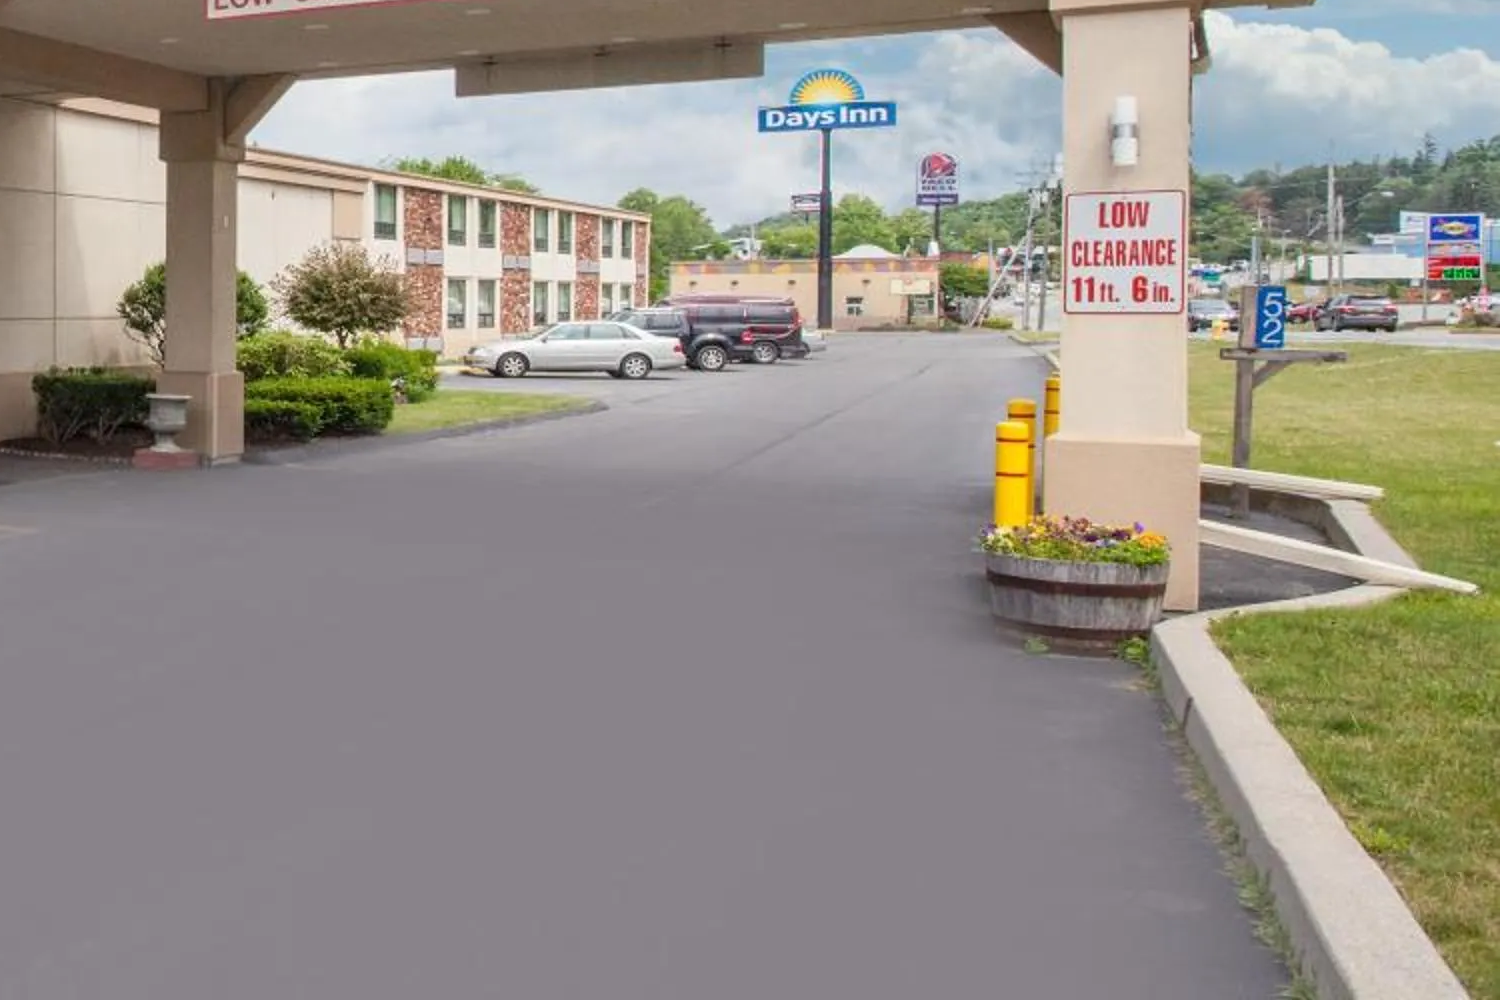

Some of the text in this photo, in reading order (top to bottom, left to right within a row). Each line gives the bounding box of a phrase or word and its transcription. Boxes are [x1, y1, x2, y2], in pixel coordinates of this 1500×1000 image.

[765, 105, 888, 129] Days Inn
[1097, 201, 1150, 229] LOW
[1071, 239, 1177, 267] CLEARANCE
